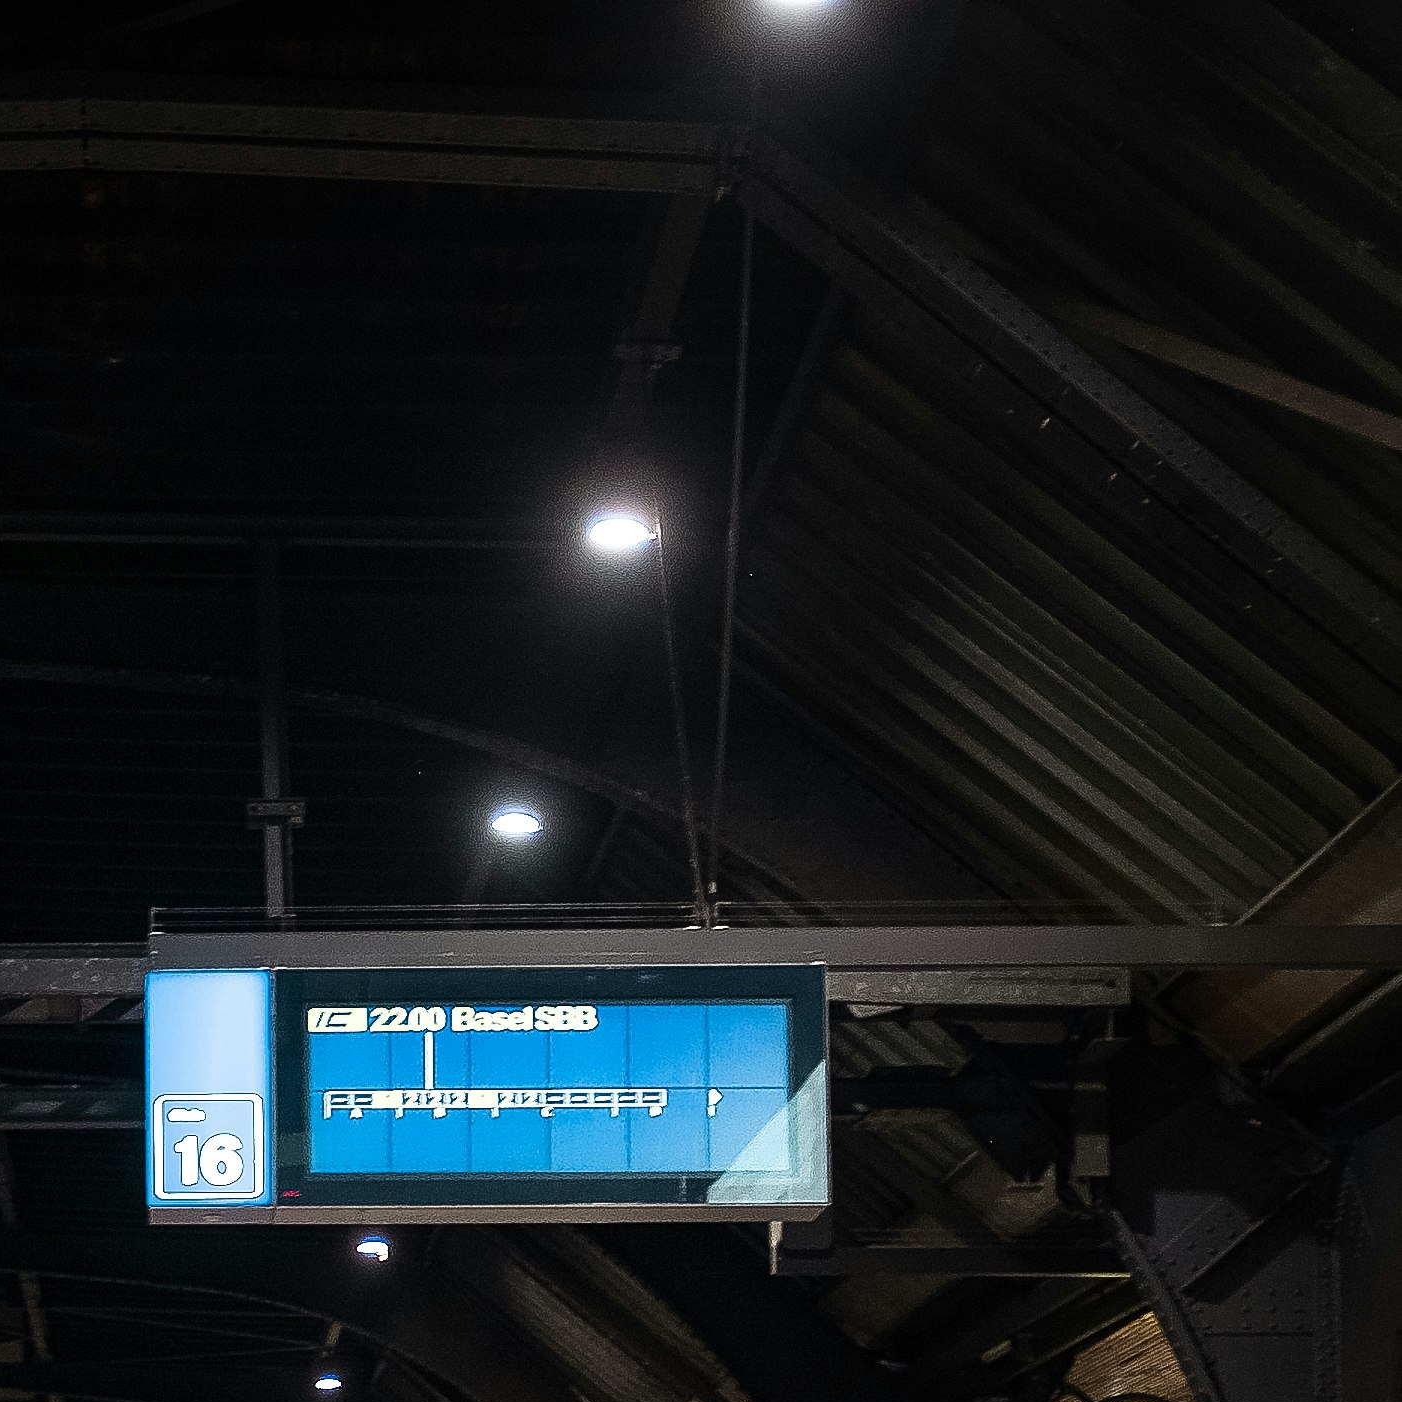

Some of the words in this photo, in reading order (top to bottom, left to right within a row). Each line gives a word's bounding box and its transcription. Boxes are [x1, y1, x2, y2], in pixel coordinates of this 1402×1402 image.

[451, 1006, 533, 1032] Basel
[534, 1006, 599, 1032] SBB
[174, 1133, 243, 1187] 16
